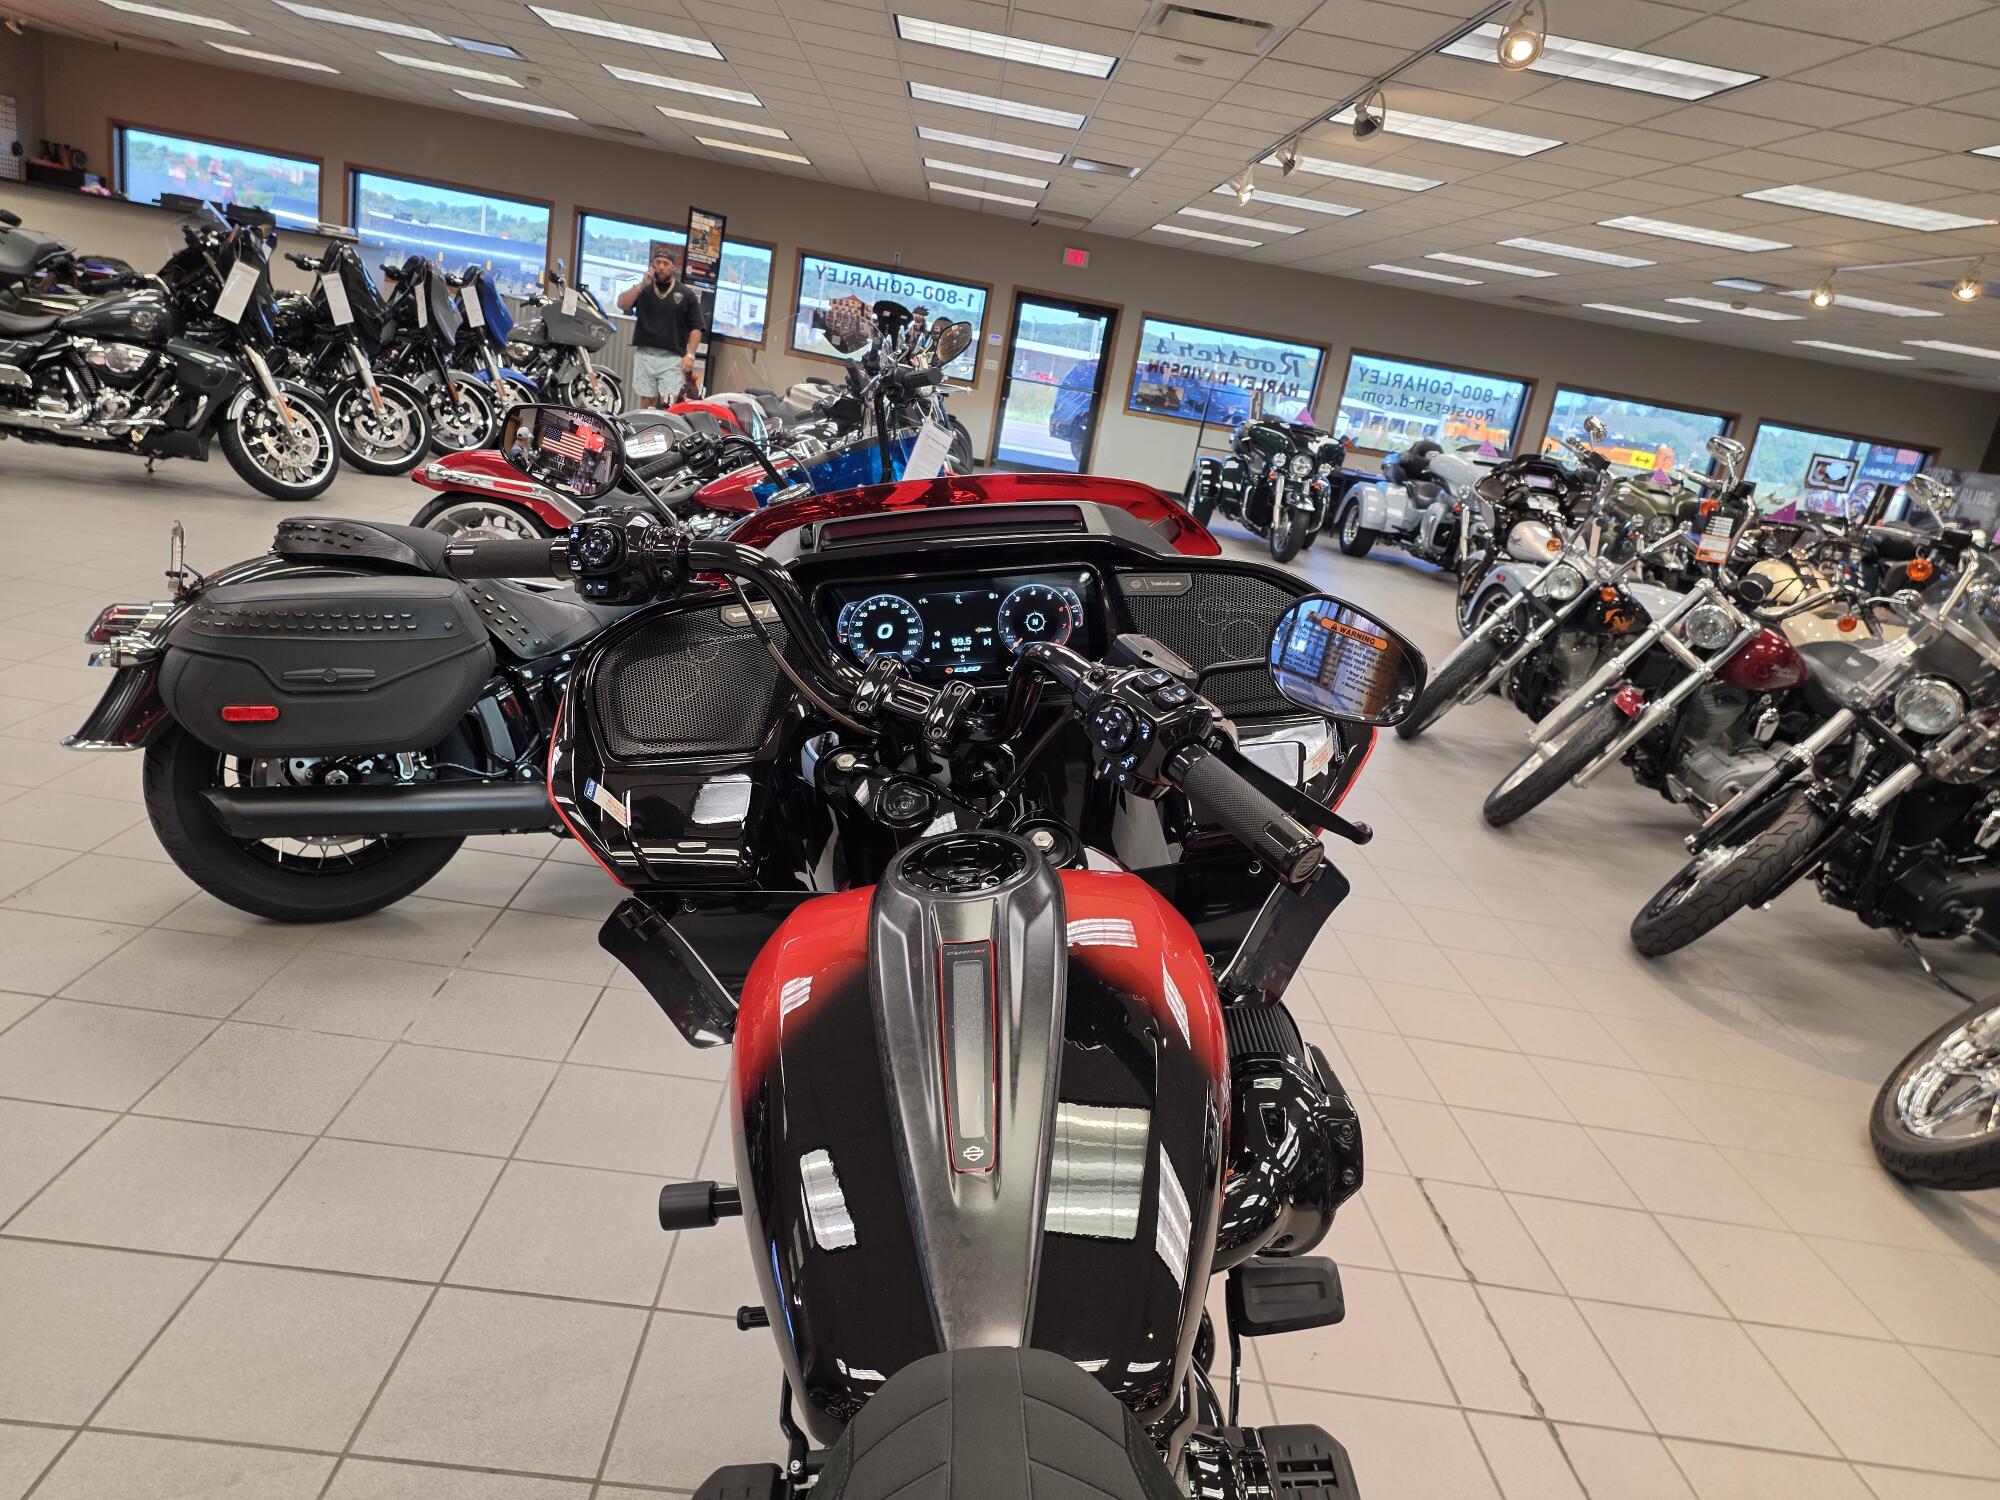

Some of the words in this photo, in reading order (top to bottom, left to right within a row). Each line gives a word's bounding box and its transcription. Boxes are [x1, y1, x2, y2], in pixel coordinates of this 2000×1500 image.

[1032, 618, 1038, 626] N
[877, 623, 894, 639] 0
[1339, 626, 1375, 644] WARNING
[951, 636, 972, 646] 99.5
[954, 665, 982, 674] CVO
